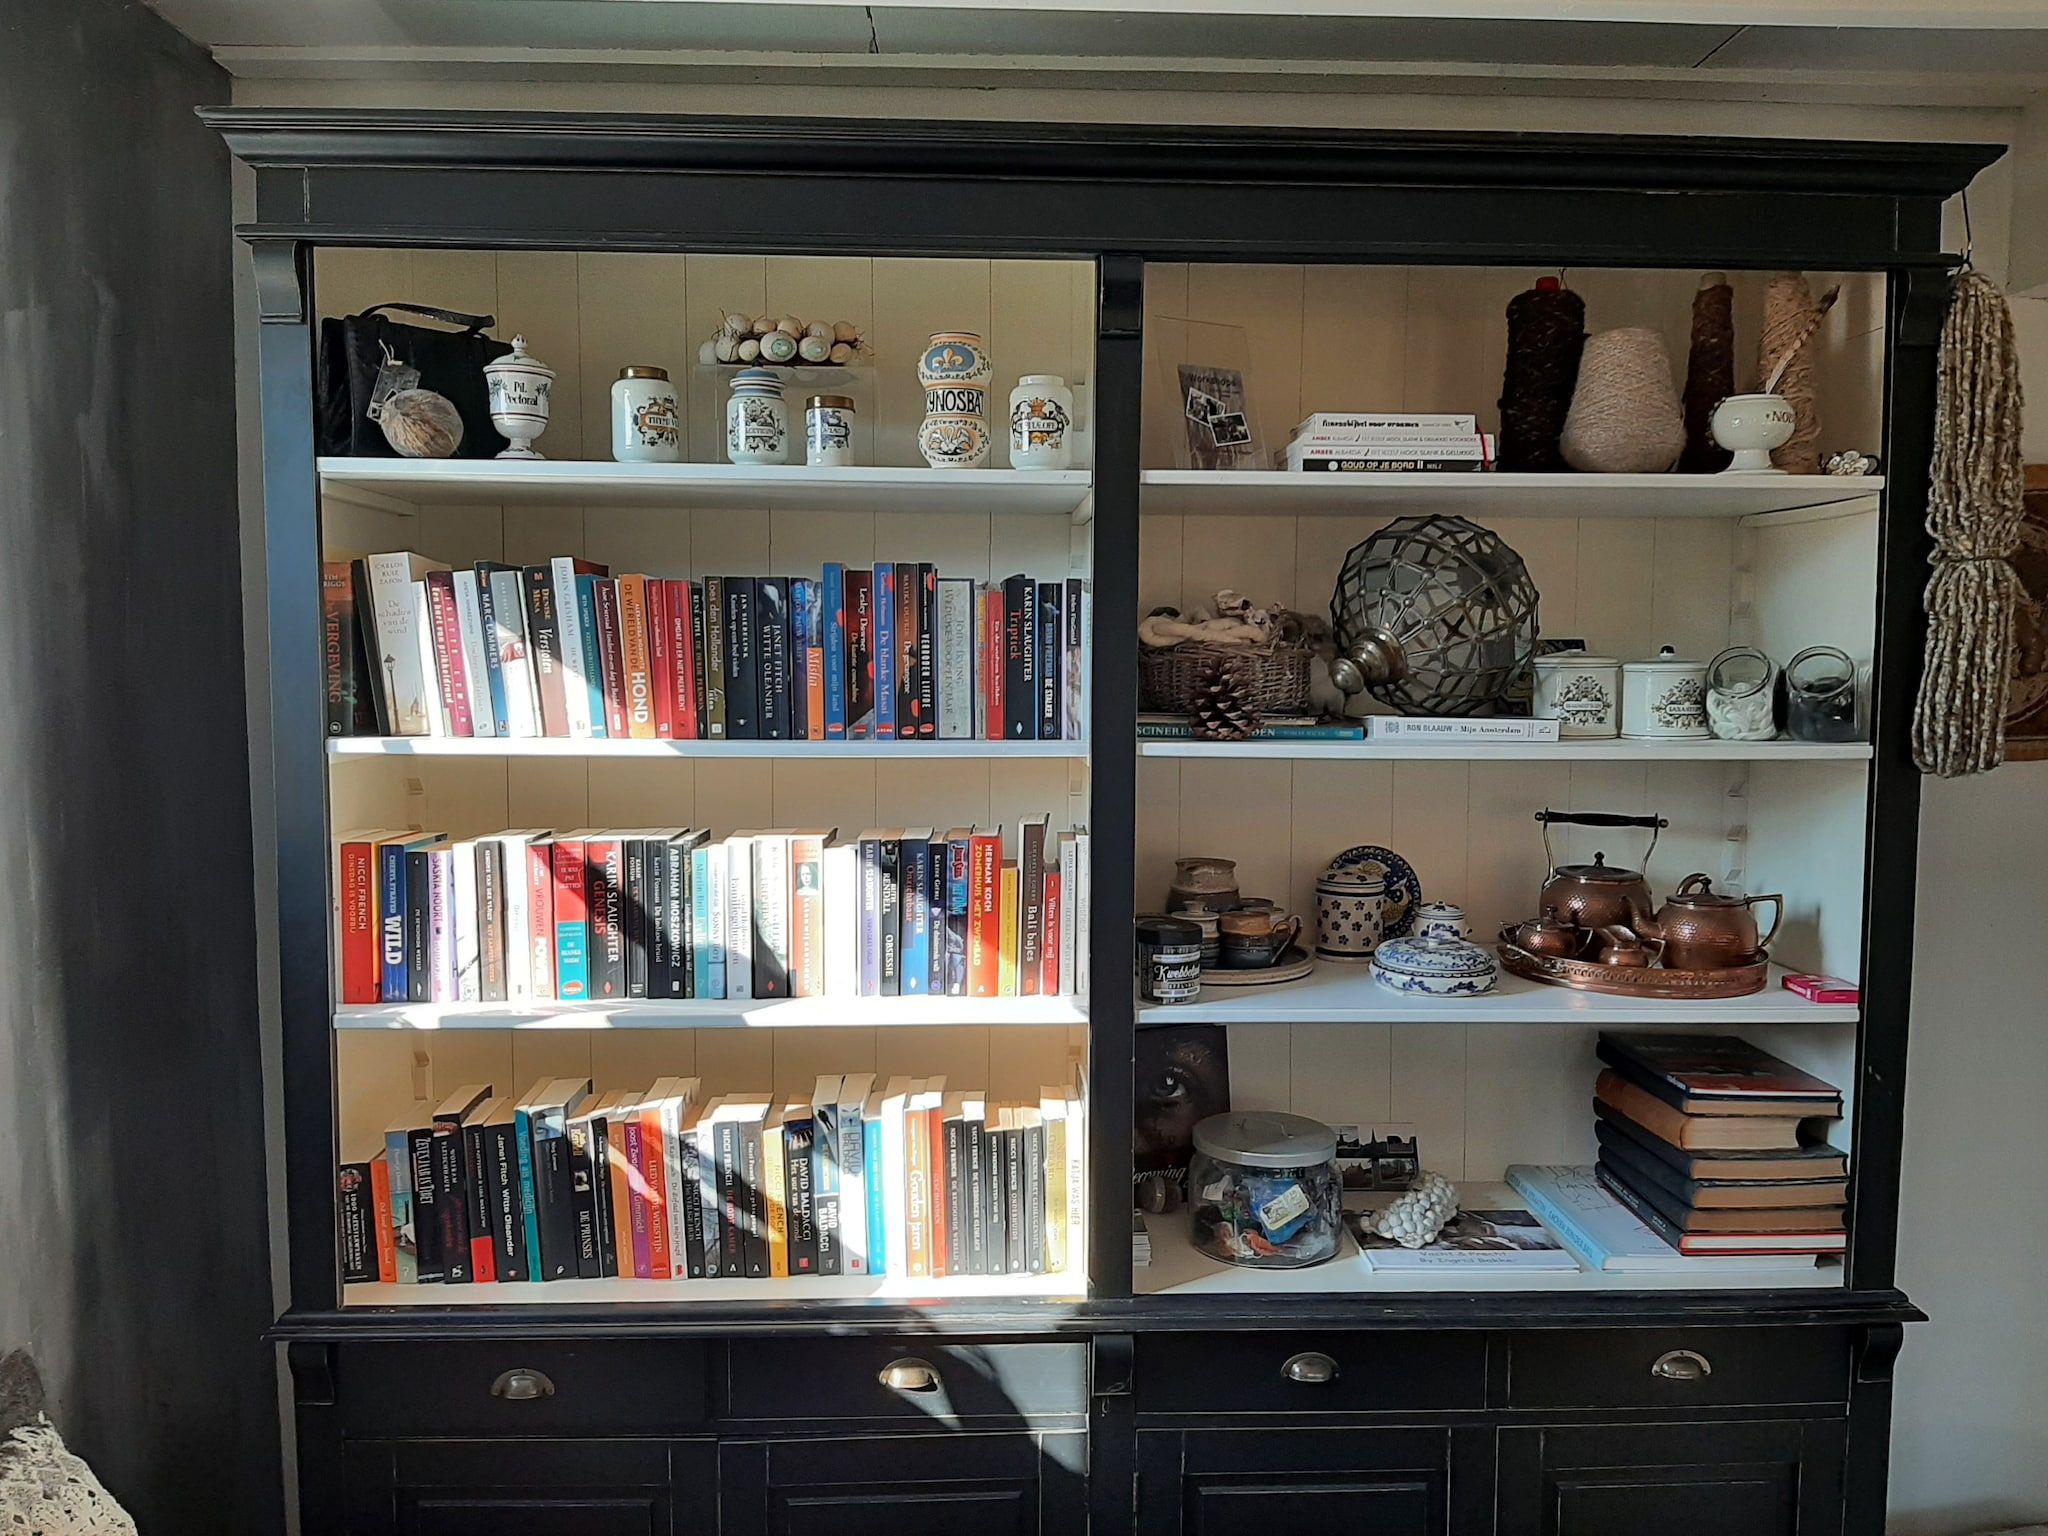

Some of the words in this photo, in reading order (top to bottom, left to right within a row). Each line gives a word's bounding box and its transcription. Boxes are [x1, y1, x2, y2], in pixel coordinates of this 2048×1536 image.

[926, 390, 983, 414] YNOSBA
[559, 566, 569, 591] JOHN
[624, 584, 633, 596] DE
[708, 580, 719, 601] Loes
[481, 593, 493, 620] MARC
[533, 588, 541, 613] MINA
[542, 588, 552, 620] DENISE
[709, 605, 719, 622] den
[740, 594, 748, 609] JAN
[858, 588, 868, 615] Lesley
[1024, 587, 1032, 620] KARIN
[563, 594, 575, 637] GRISHAM
[625, 599, 635, 635] WERELD
[486, 623, 498, 669] LAMMERS
[627, 637, 637, 656] VAN
[762, 625, 772, 659] WITTE
[771, 624, 782, 656] JANET
[880, 631, 889, 646] De
[903, 640, 912, 652] De
[955, 619, 965, 647] JOHN
[326, 611, 341, 704] VERGEVING
[710, 625, 721, 672] Hollander
[1024, 621, 1033, 682] SLAUGHTER
[629, 658, 638, 670] DE
[676, 659, 684, 674] NIET
[774, 661, 783, 693] FITCH
[880, 648, 890, 681] blanke
[956, 650, 965, 685] IRVING
[763, 663, 773, 719] OLEANDER
[831, 674, 839, 692] mijn
[1045, 678, 1053, 687] DE
[631, 672, 648, 723] HOND
[678, 694, 686, 711] BENT
[832, 694, 840, 711] land
[880, 684, 890, 714] Masai
[1045, 689, 1053, 718] STALKER
[357, 857, 365, 886] NICCI
[432, 858, 442, 889] SASKIA
[606, 851, 617, 889] KARIN
[670, 848, 679, 897] ABRAHAM
[916, 852, 924, 881] KARIN
[974, 845, 982, 897] ZOMERHUIS
[984, 845, 992, 884] HERMAN
[349, 890, 355, 898] IS
[432, 892, 443, 922] NOORT
[594, 880, 606, 935] GENESIS
[882, 872, 890, 914] RENDELL
[905, 865, 914, 923] Onzichtbaar
[984, 887, 992, 912] KOCH
[357, 888, 366, 930] FRENCH
[915, 882, 924, 934] SLAUGHTER
[974, 899, 982, 918] MET
[1027, 905, 1038, 929] Bali
[607, 892, 619, 963] SLAUGHTER
[670, 900, 680, 967] MOSZKOWICZ
[933, 920, 940, 929] De
[384, 915, 402, 965] WILD
[973, 920, 982, 966] ZWEMBAD
[1025, 932, 1038, 962] bajes
[885, 934, 894, 977] OBSESSIE
[497, 1134, 505, 1161] Janet
[519, 1131, 529, 1164] Voeding
[628, 1126, 638, 1146] Joost
[722, 1129, 730, 1153] NICCI
[499, 1162, 508, 1185] Fitch
[521, 1166, 529, 1178] als
[648, 1159, 658, 1179] LIED
[723, 1154, 733, 1186] FRENCH
[790, 1159, 799, 1175] Het
[799, 1158, 809, 1189] DAVID
[1071, 1159, 1080, 1184] KATJA
[1133, 1165, 1187, 1184] ecoming
[521, 1180, 534, 1214] medicijn
[671, 1182, 678, 1190] De
[910, 1169, 924, 1218] Gouden
[1071, 1186, 1081, 1205] WAS
[501, 1189, 510, 1214] Witte
[580, 1210, 590, 1222] DE
[792, 1208, 800, 1217] de
[827, 1201, 837, 1228] DAVID
[1071, 1207, 1081, 1225] HIER
[792, 1220, 801, 1242] zonde
[800, 1192, 810, 1241] BALDACCI
[818, 1208, 829, 1252] BALDACCI
[581, 1224, 592, 1259] PRINSES
[651, 1213, 662, 1253] WOESTIJN
[908, 1222, 923, 1250] jaren
